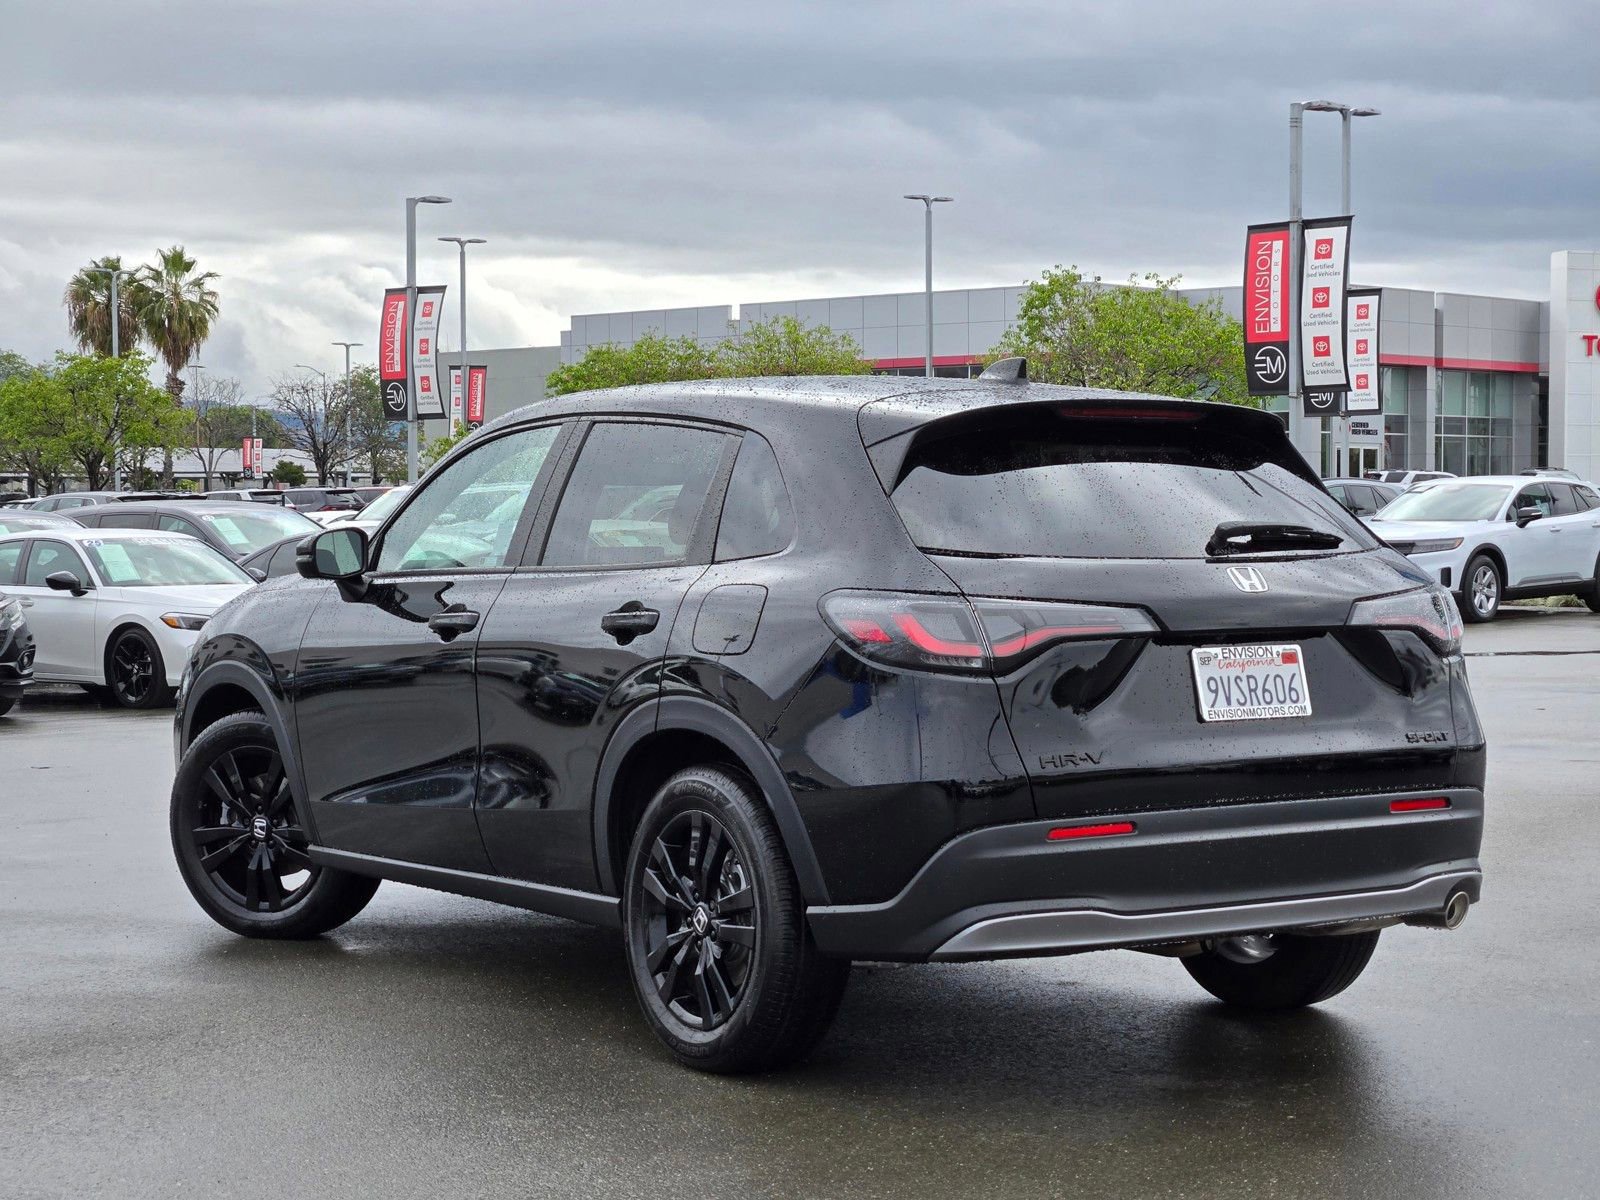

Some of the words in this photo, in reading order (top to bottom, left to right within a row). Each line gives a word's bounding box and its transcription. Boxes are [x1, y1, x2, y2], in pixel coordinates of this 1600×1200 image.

[1310, 263, 1335, 271] Certified
[1254, 240, 1272, 334] ENVISION
[1272, 248, 1281, 325] MOTORS
[385, 301, 399, 373] ENVISION
[1582, 335, 1600, 356] T
[470, 372, 479, 417] ENVISION
[1199, 656, 1212, 666] SEP
[1221, 646, 1274, 659] ENVISION
[1217, 658, 1277, 672] California
[1206, 672, 1300, 708] 9VSR606
[1208, 705, 1308, 720] ENVISIONMOTORS.COM
[1038, 750, 1104, 770] HR-V
